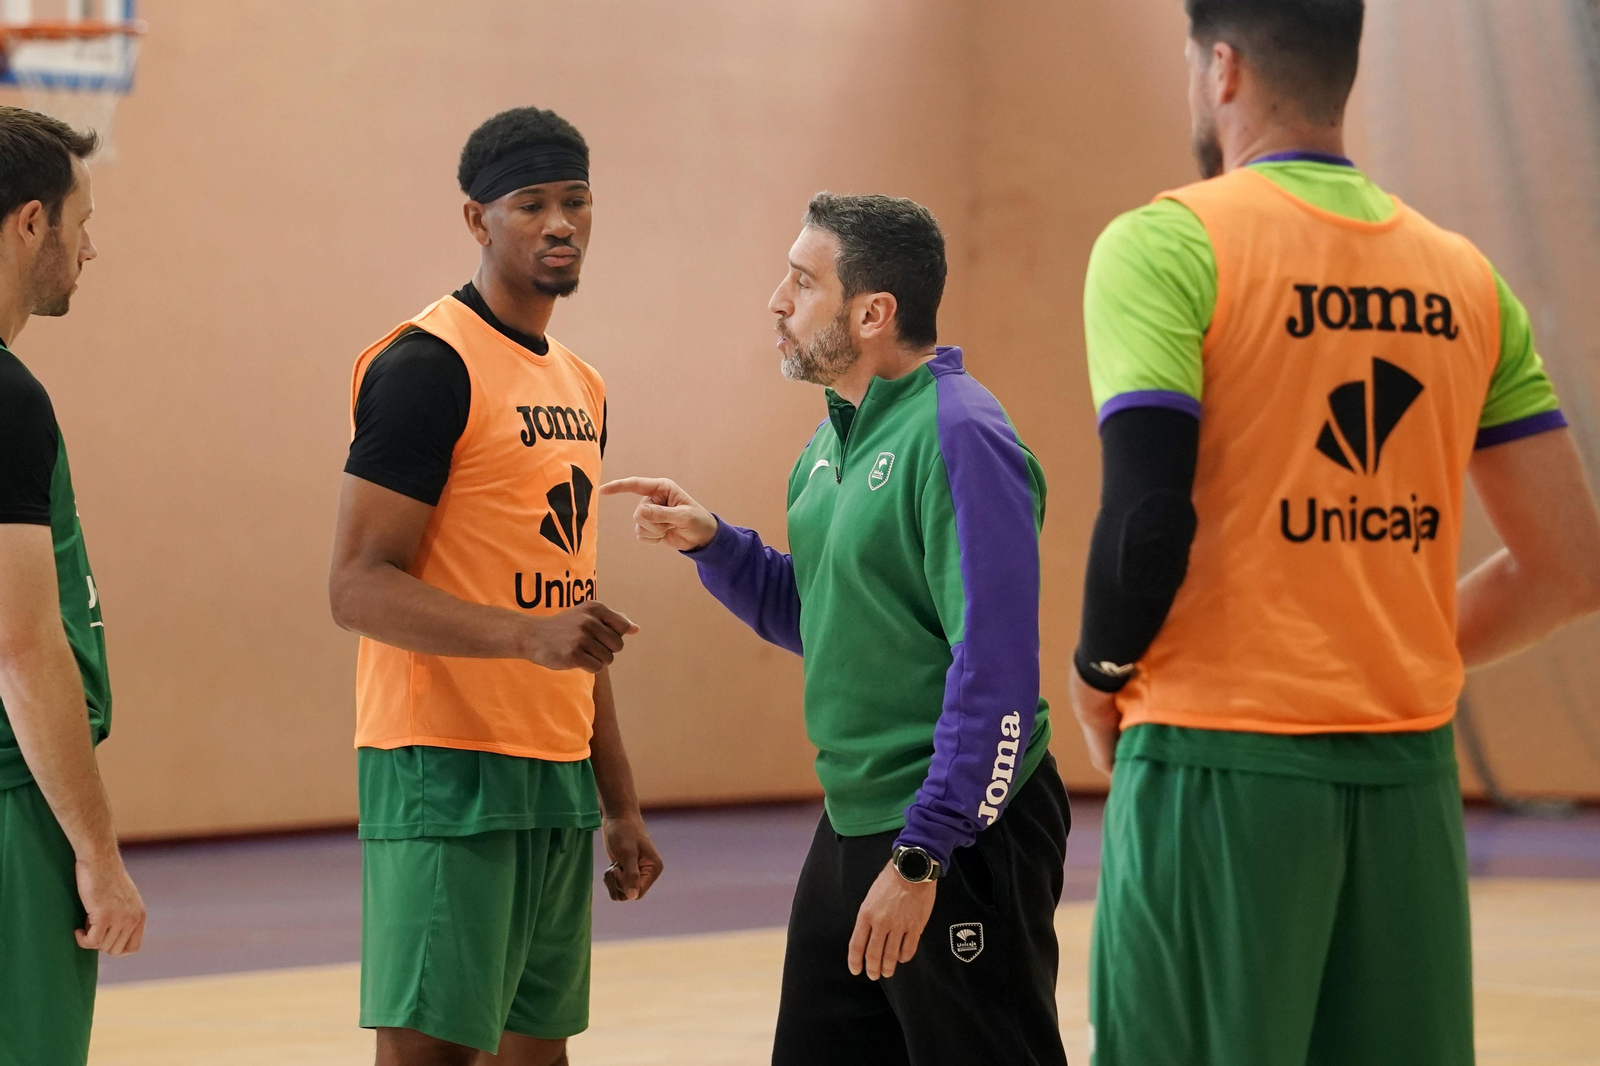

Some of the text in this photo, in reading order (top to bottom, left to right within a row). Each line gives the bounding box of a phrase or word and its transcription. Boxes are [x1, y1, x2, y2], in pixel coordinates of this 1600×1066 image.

[1286, 283, 1459, 341] Joma
[516, 405, 598, 447] Joma
[1280, 493, 1440, 553] Unicaja
[977, 710, 1021, 826] Joma
